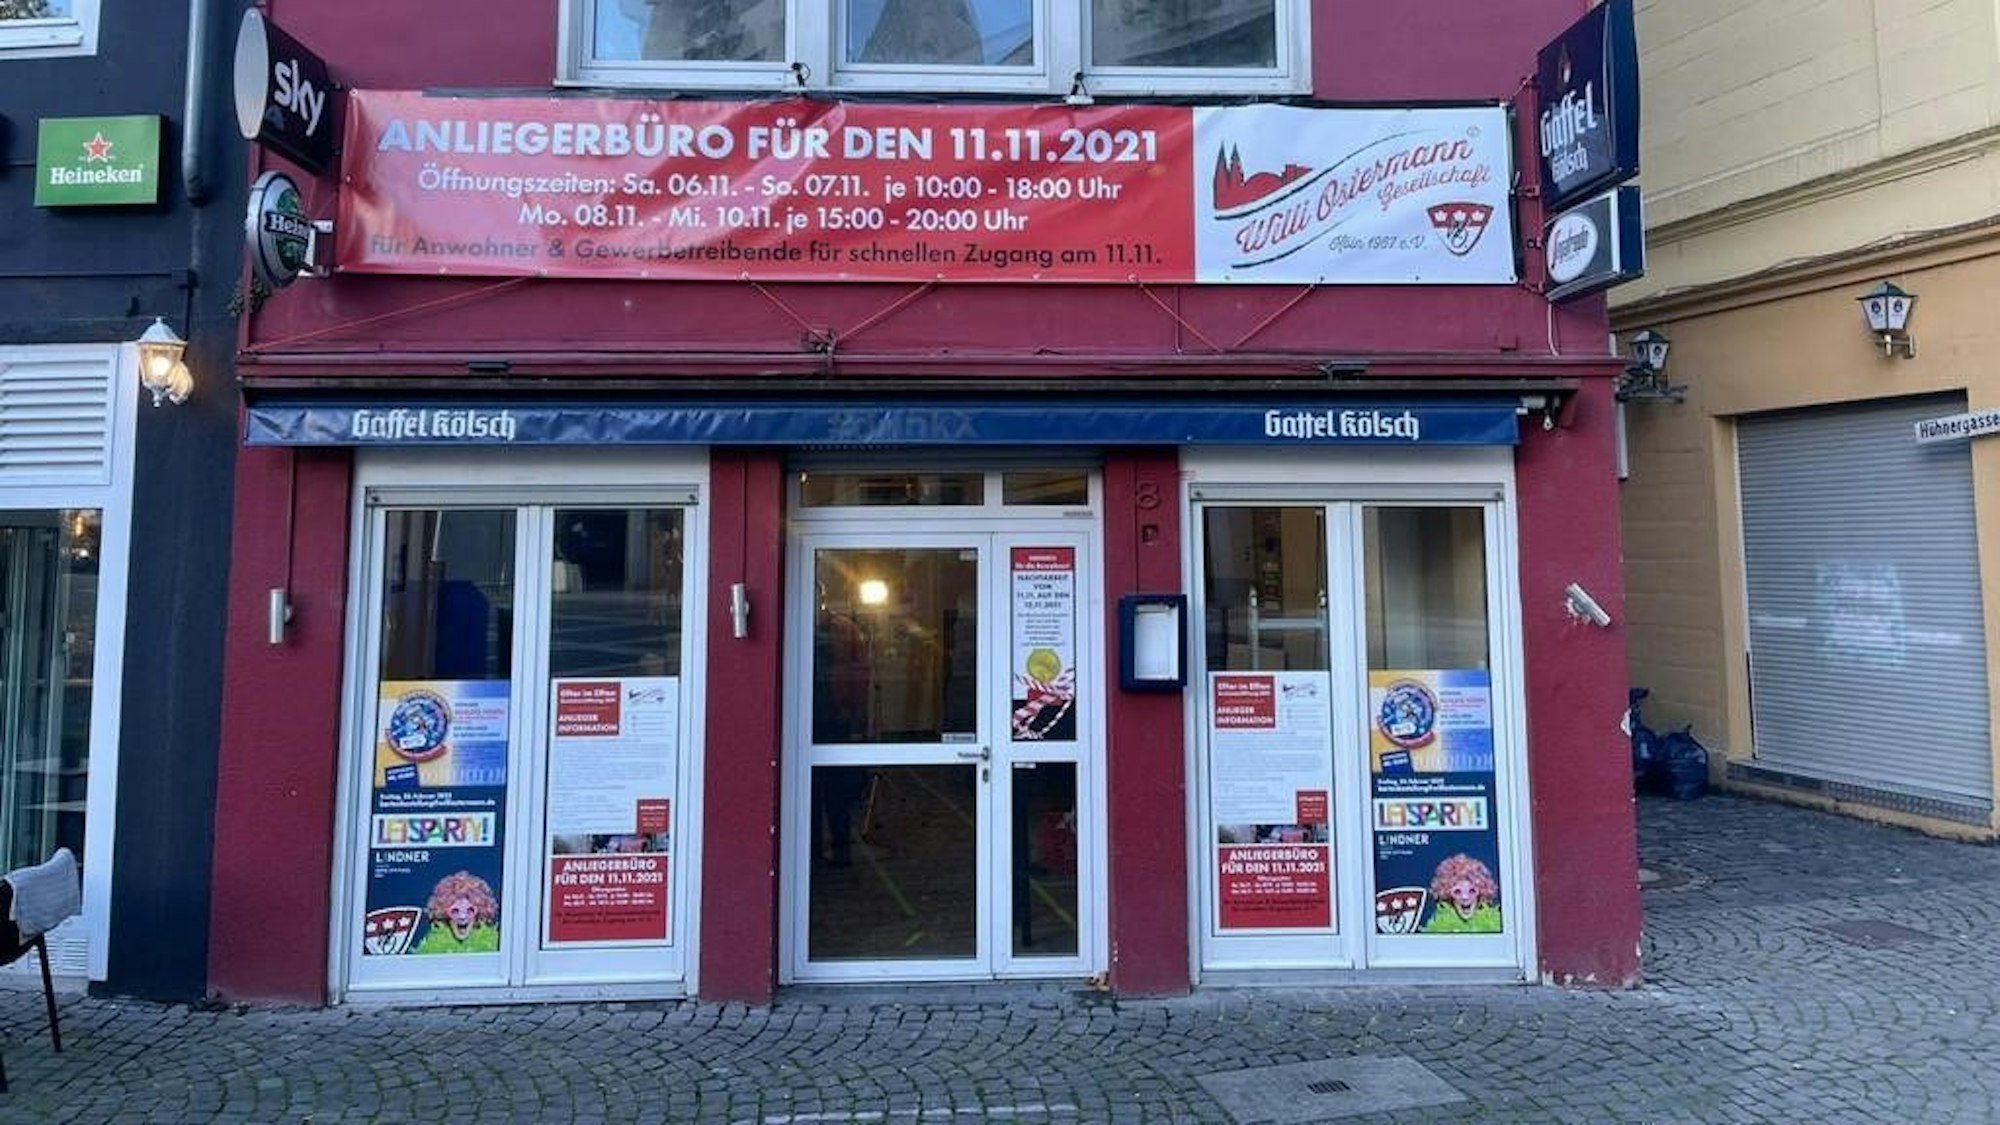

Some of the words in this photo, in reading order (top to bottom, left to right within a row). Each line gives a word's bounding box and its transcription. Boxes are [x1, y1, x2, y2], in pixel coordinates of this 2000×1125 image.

[274, 59, 325, 137] sky
[1540, 80, 1597, 158] Gaffel
[378, 113, 735, 158] ANLIEGERBÜRO
[748, 117, 829, 160] FÜR
[844, 126, 932, 160] DEN
[950, 129, 1158, 162] 11.11.2021
[50, 165, 143, 185] Heineken
[418, 163, 616, 198] Öffnungszeiten:
[622, 173, 662, 196] Sa.
[668, 175, 737, 197] 06.11.
[761, 175, 798, 197] So.
[806, 176, 869, 198] 07.11.
[884, 176, 906, 203] je
[914, 177, 981, 199] 10:00
[1006, 178, 1071, 199] 18:00
[1078, 177, 1122, 199] Uhr
[1377, 165, 1491, 211] Gesellschaft
[1235, 202, 1310, 252] Willi
[1316, 138, 1473, 222] Ostermann
[519, 204, 568, 225] Mo.
[575, 205, 644, 227] 08.11.
[669, 206, 706, 228] Mi.
[717, 206, 779, 229] 10.11.
[786, 206, 808, 234] je
[817, 207, 884, 230] 15:00
[906, 209, 977, 231] 20:00
[984, 208, 1028, 231] Uhr
[371, 235, 402, 255] für
[412, 235, 537, 258] Anwohner
[548, 240, 565, 258] &
[575, 239, 801, 261] Gewerbetreibende
[809, 242, 841, 263] für
[849, 243, 956, 263] schnellen
[963, 245, 1053, 268] Zugang
[1061, 249, 1096, 263] am
[1105, 245, 1162, 264] 11.11.
[352, 408, 428, 440] Gaffel
[432, 409, 517, 441] Kölsch
[1341, 409, 1419, 441] Kölsch
[1230, 848, 1319, 861] ANLIEGERBÜRO
[1378, 834, 1430, 845] LINDNER
[375, 850, 430, 863] LINDNER
[563, 858, 657, 871] ANLIEGERBÜRO
